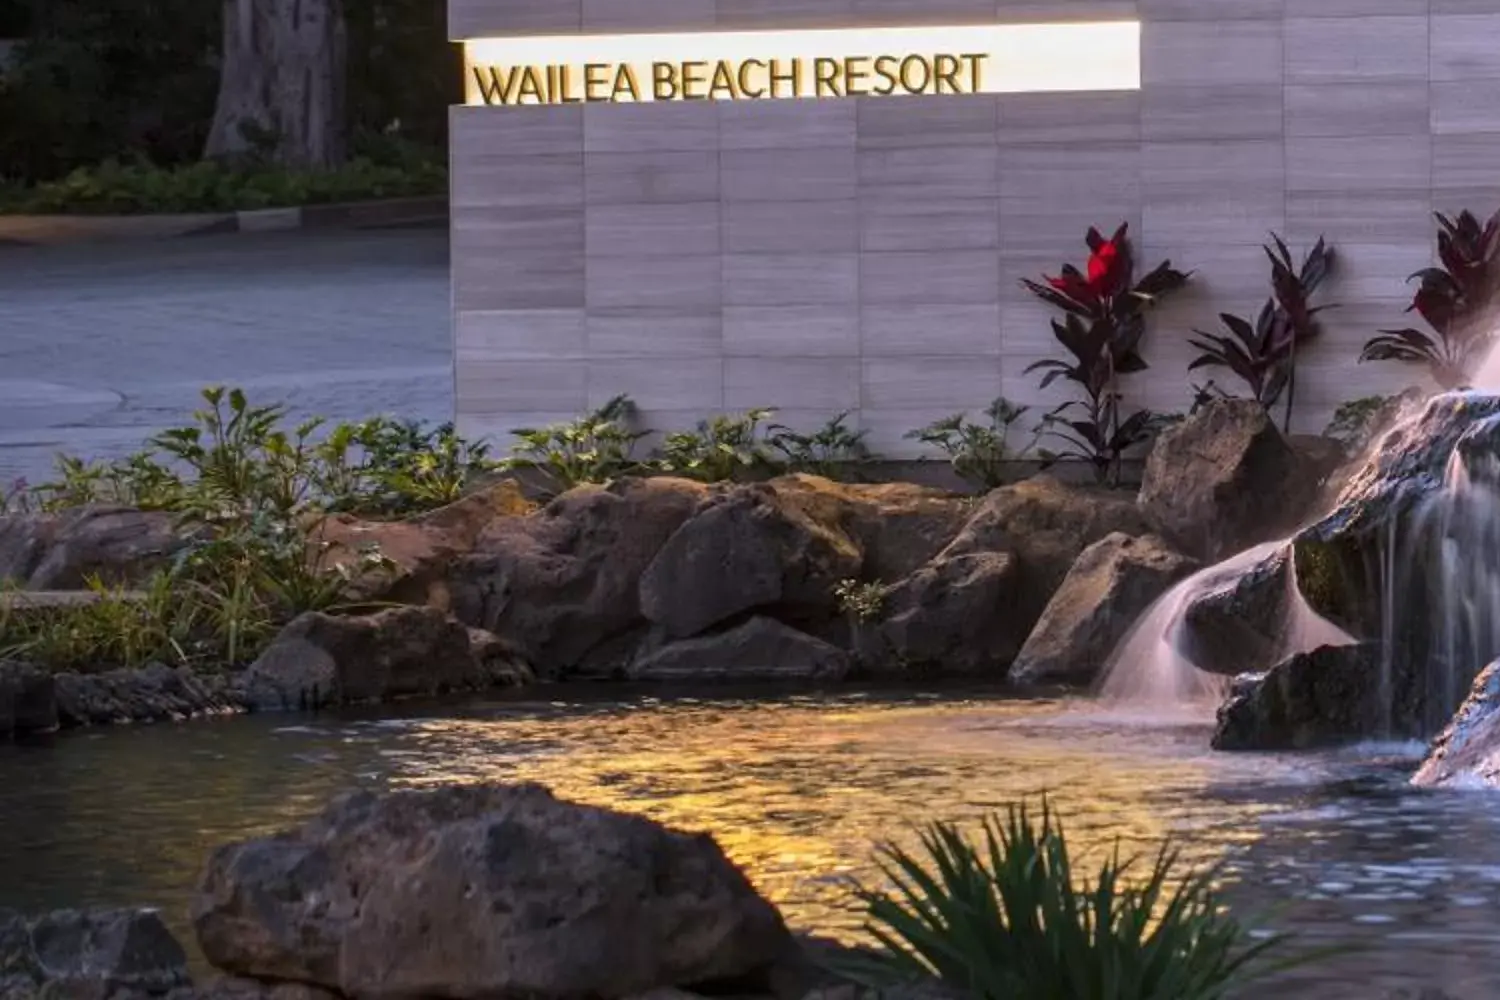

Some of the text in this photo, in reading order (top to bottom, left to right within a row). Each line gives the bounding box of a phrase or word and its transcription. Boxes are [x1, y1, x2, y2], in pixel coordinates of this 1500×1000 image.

[473, 53, 989, 105] WAILEA BEACH RESORT
